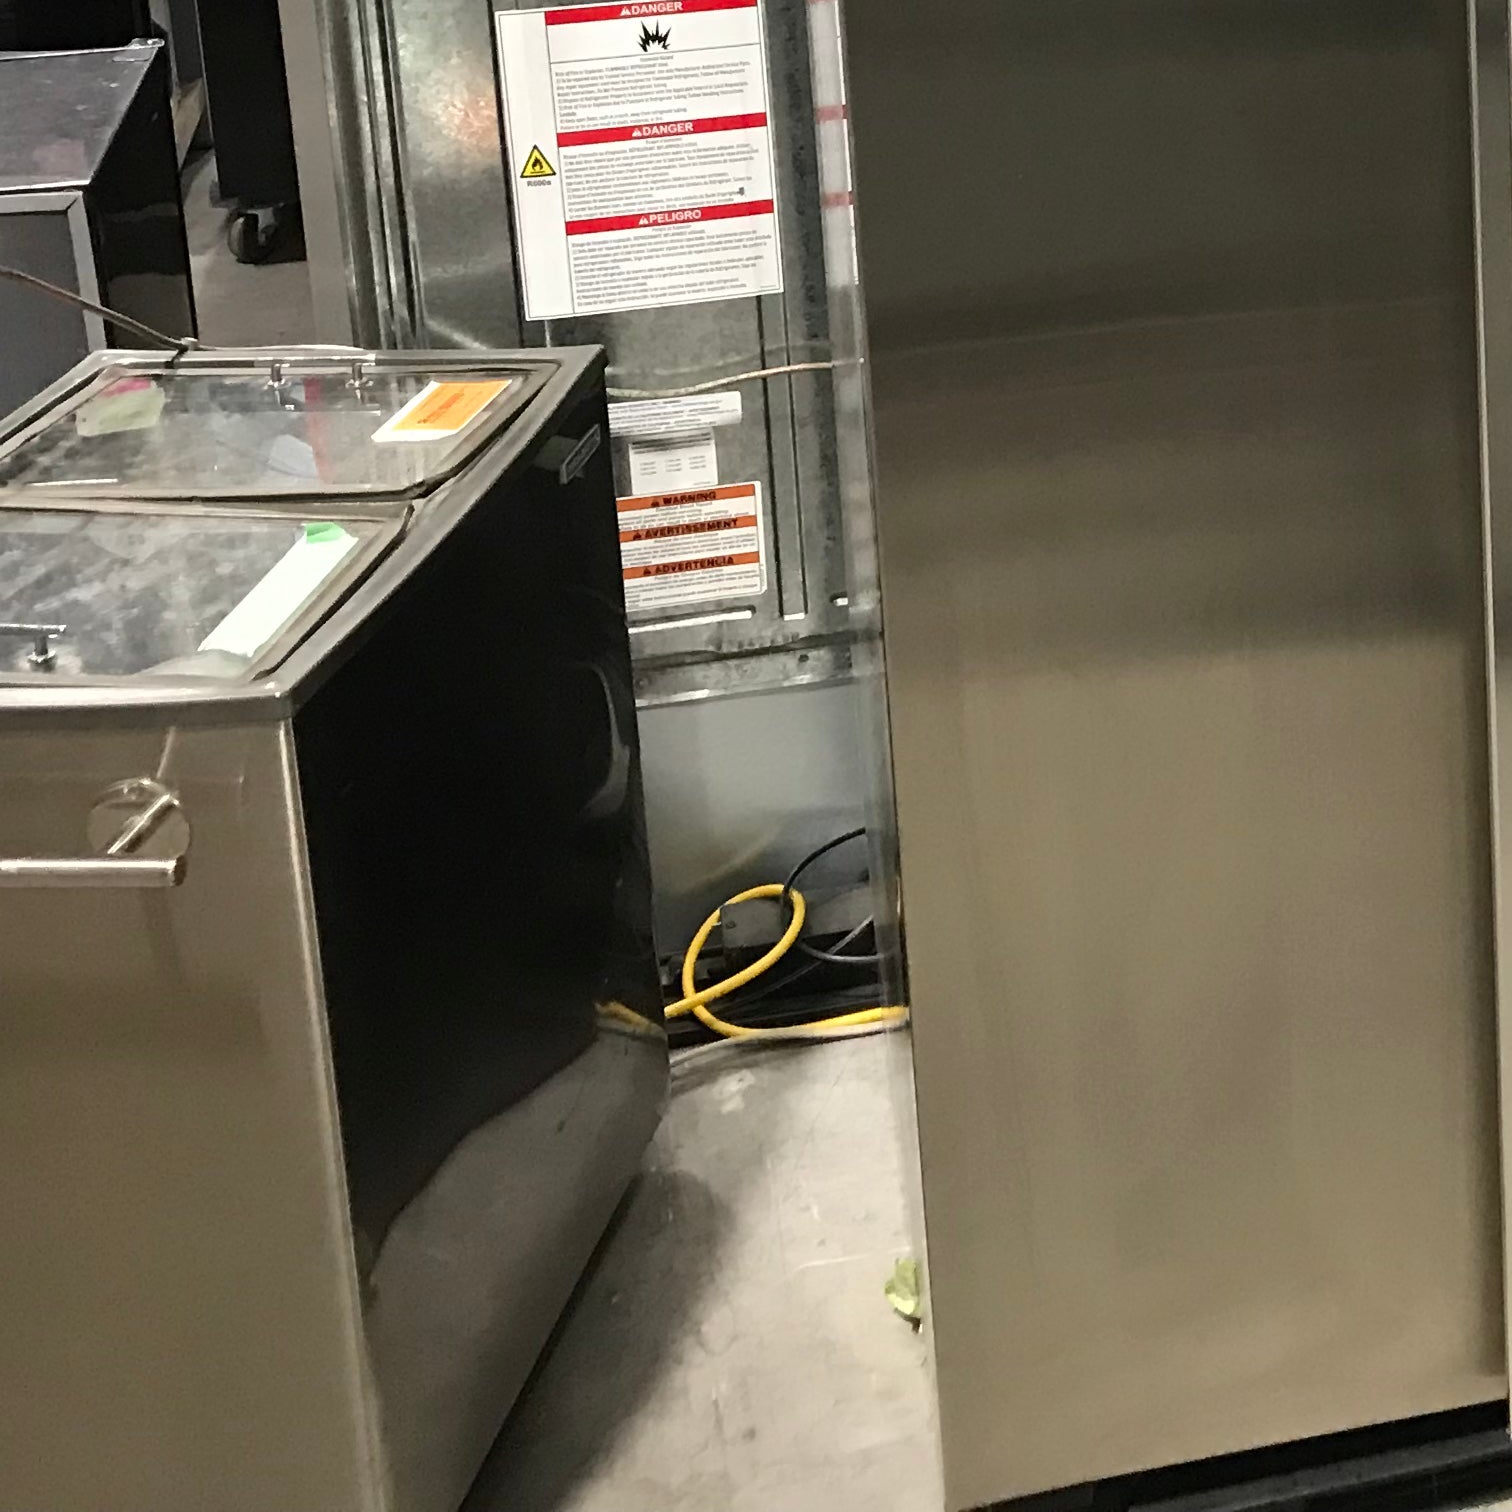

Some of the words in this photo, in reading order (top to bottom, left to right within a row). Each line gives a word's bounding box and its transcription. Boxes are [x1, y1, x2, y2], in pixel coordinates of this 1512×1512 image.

[631, 0, 684, 16] DANGER
[642, 121, 694, 137] DANGER
[648, 209, 702, 224] PELIGRO
[662, 491, 717, 505] WARNING
[644, 519, 738, 537] AVERTISSEMENT
